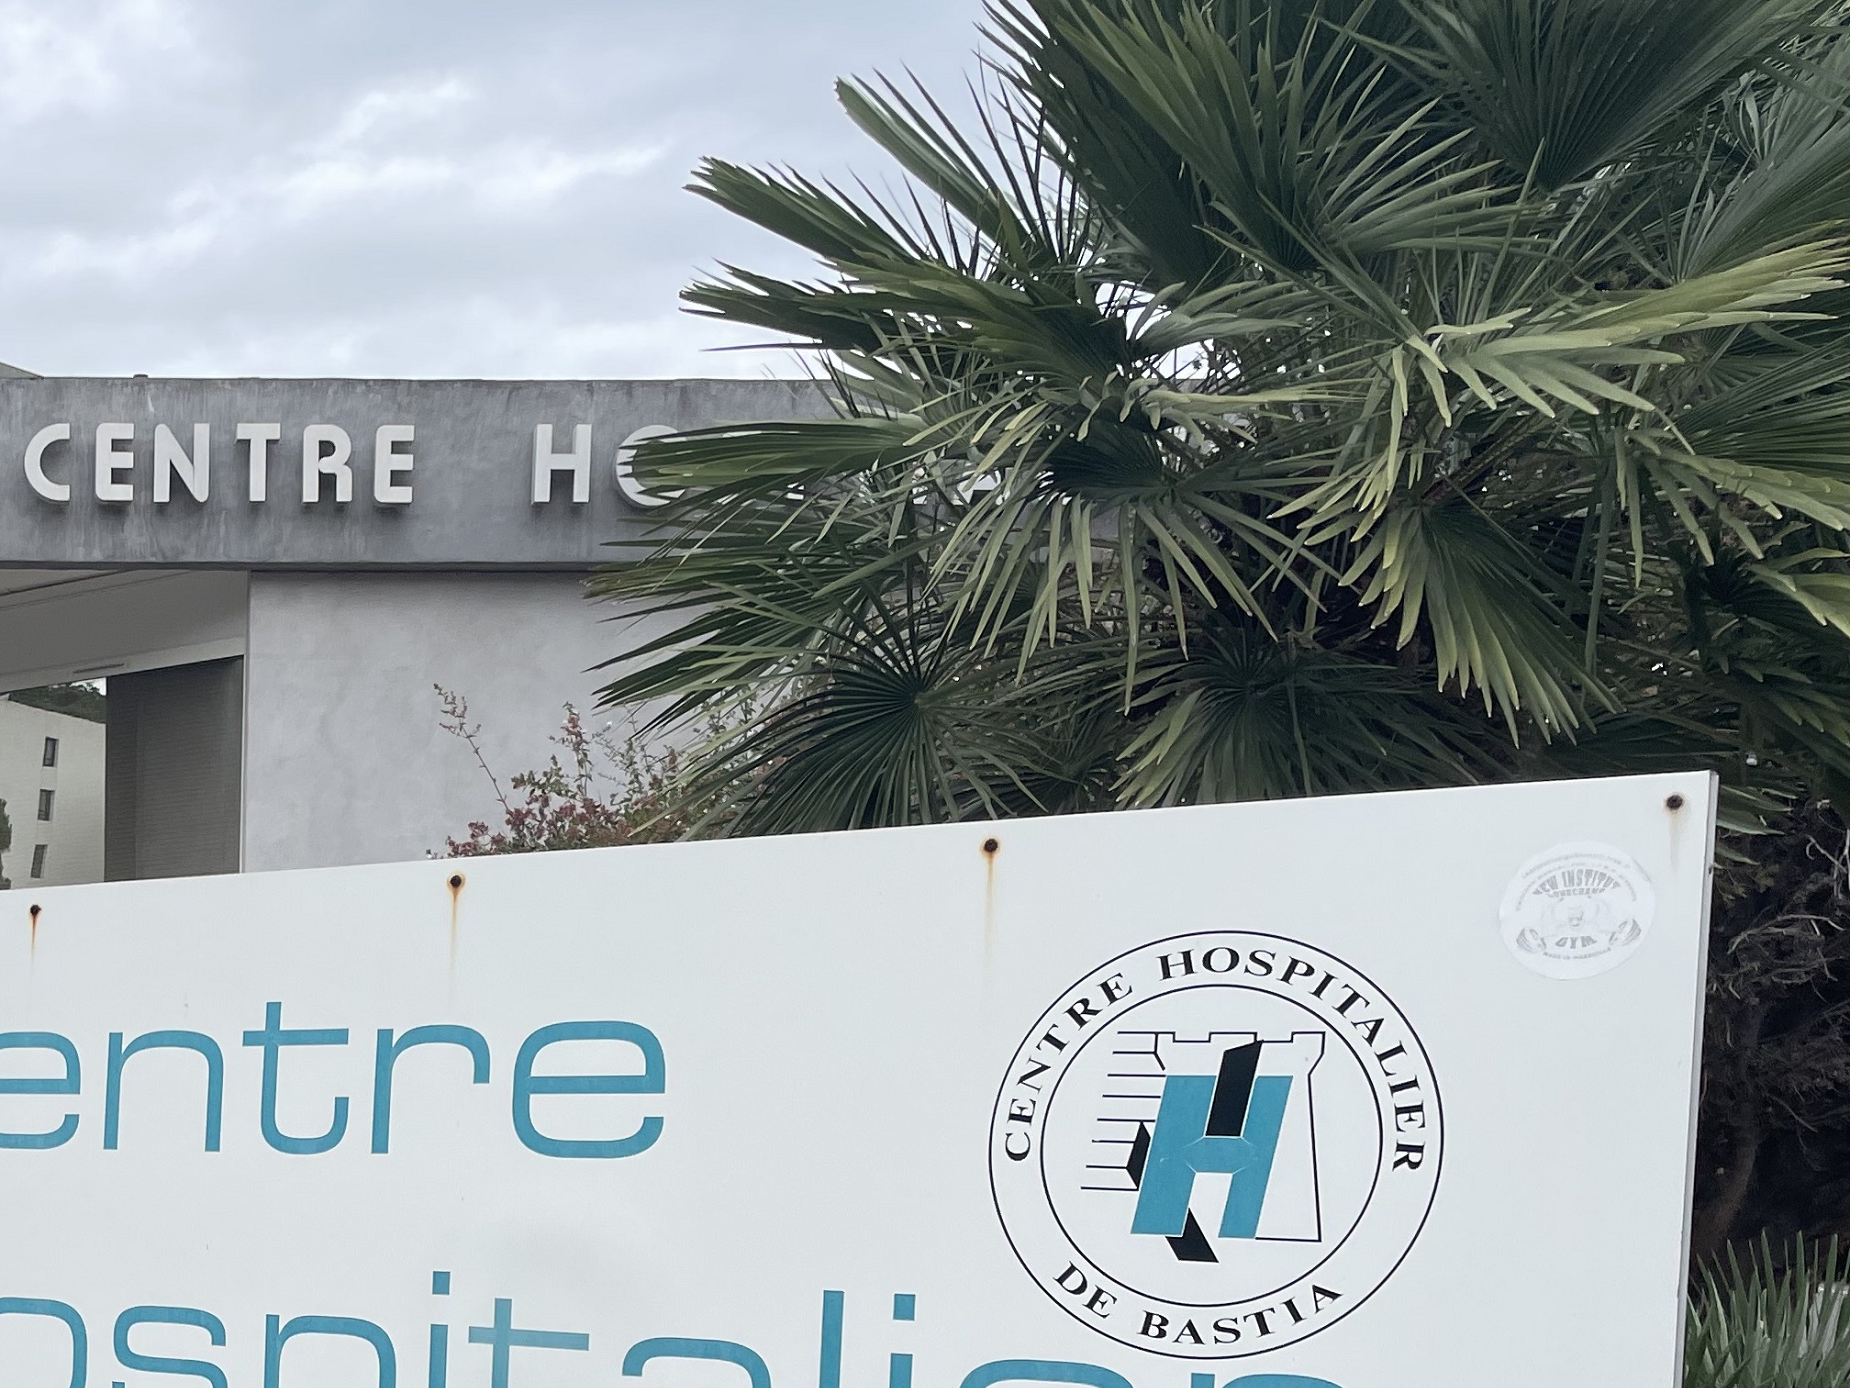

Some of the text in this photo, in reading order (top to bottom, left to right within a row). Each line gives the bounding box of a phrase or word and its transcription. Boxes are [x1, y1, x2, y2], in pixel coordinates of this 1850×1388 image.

[23, 422, 416, 504] CENTRE
[1555, 936, 1598, 949] GYM
[1005, 946, 1426, 1172] CENTRE HOSPITALIER
[1053, 1261, 1344, 1346] DE BASTIA
